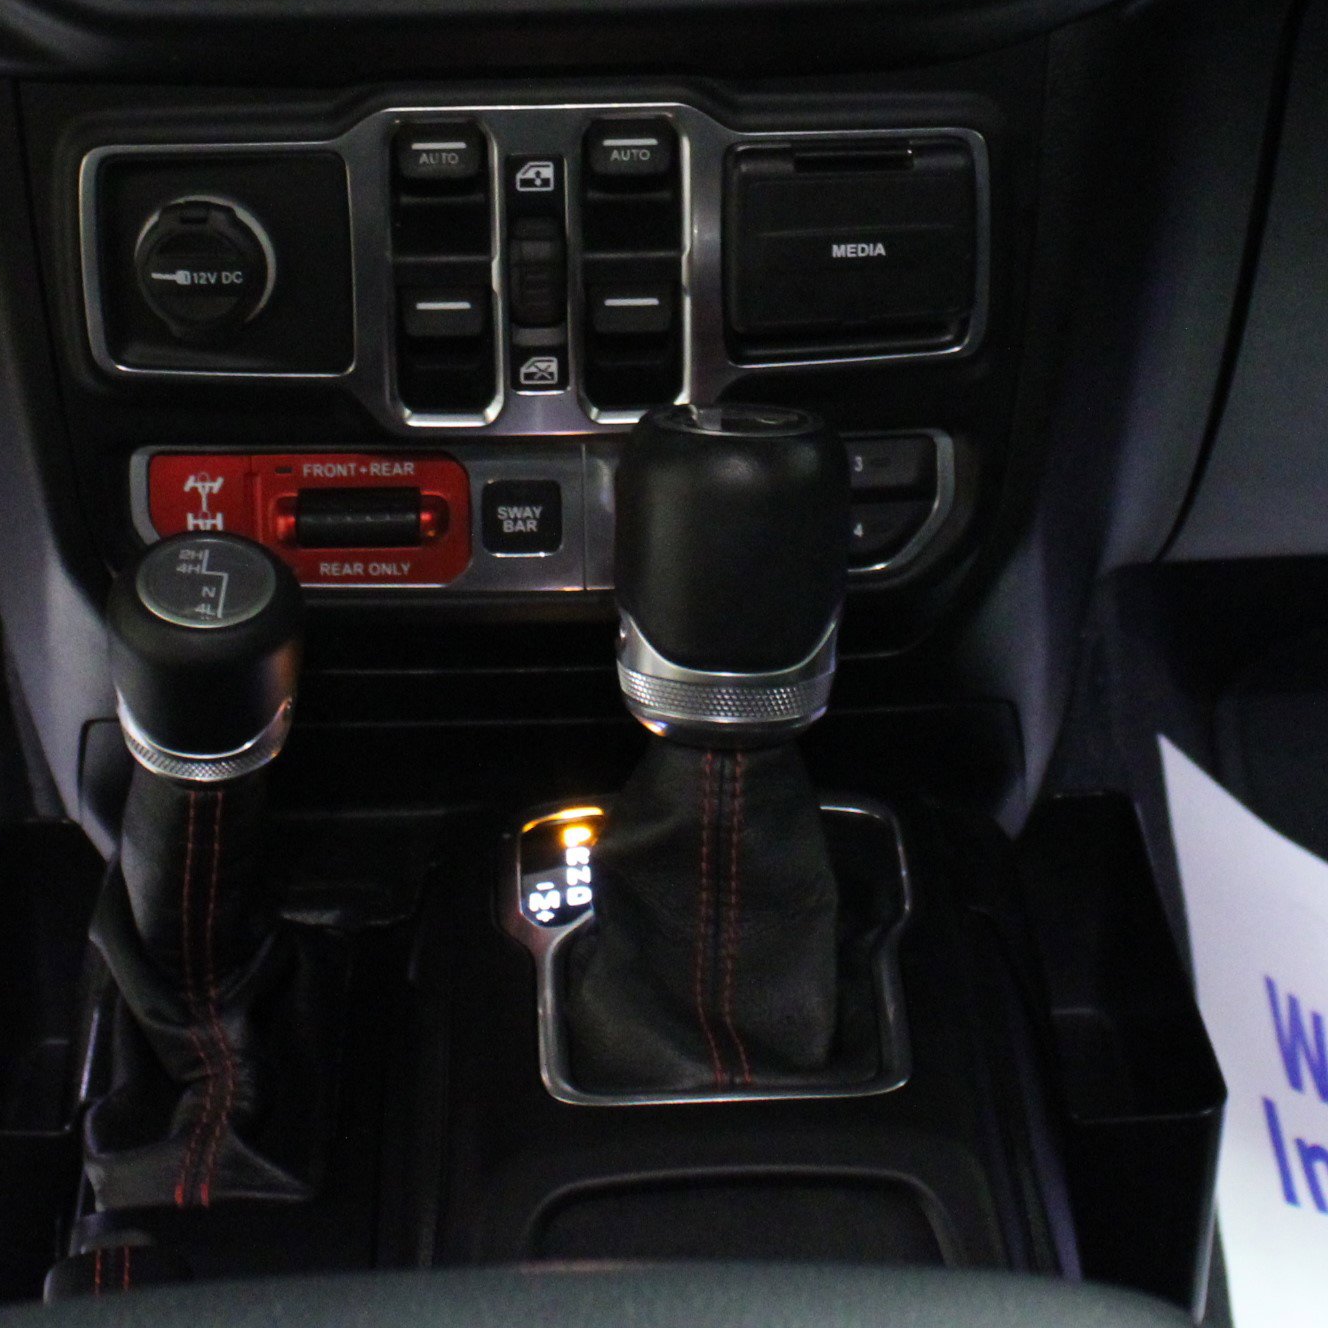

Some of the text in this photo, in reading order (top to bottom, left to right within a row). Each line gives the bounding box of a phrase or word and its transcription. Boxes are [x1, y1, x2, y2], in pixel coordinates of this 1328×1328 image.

[419, 152, 459, 165] AUTO
[610, 149, 651, 162] AUTO
[831, 241, 887, 259] MEDIA
[192, 271, 244, 285] 12V DC
[854, 455, 864, 472] 3
[497, 505, 544, 520] SWAY
[503, 520, 538, 533] BAR
[175, 563, 202, 574] 4H
[320, 562, 411, 576] REAR ONLY
[202, 586, 217, 599] N
[194, 603, 217, 616] 4L
[529, 890, 561, 912] M
[566, 886, 593, 906] D
